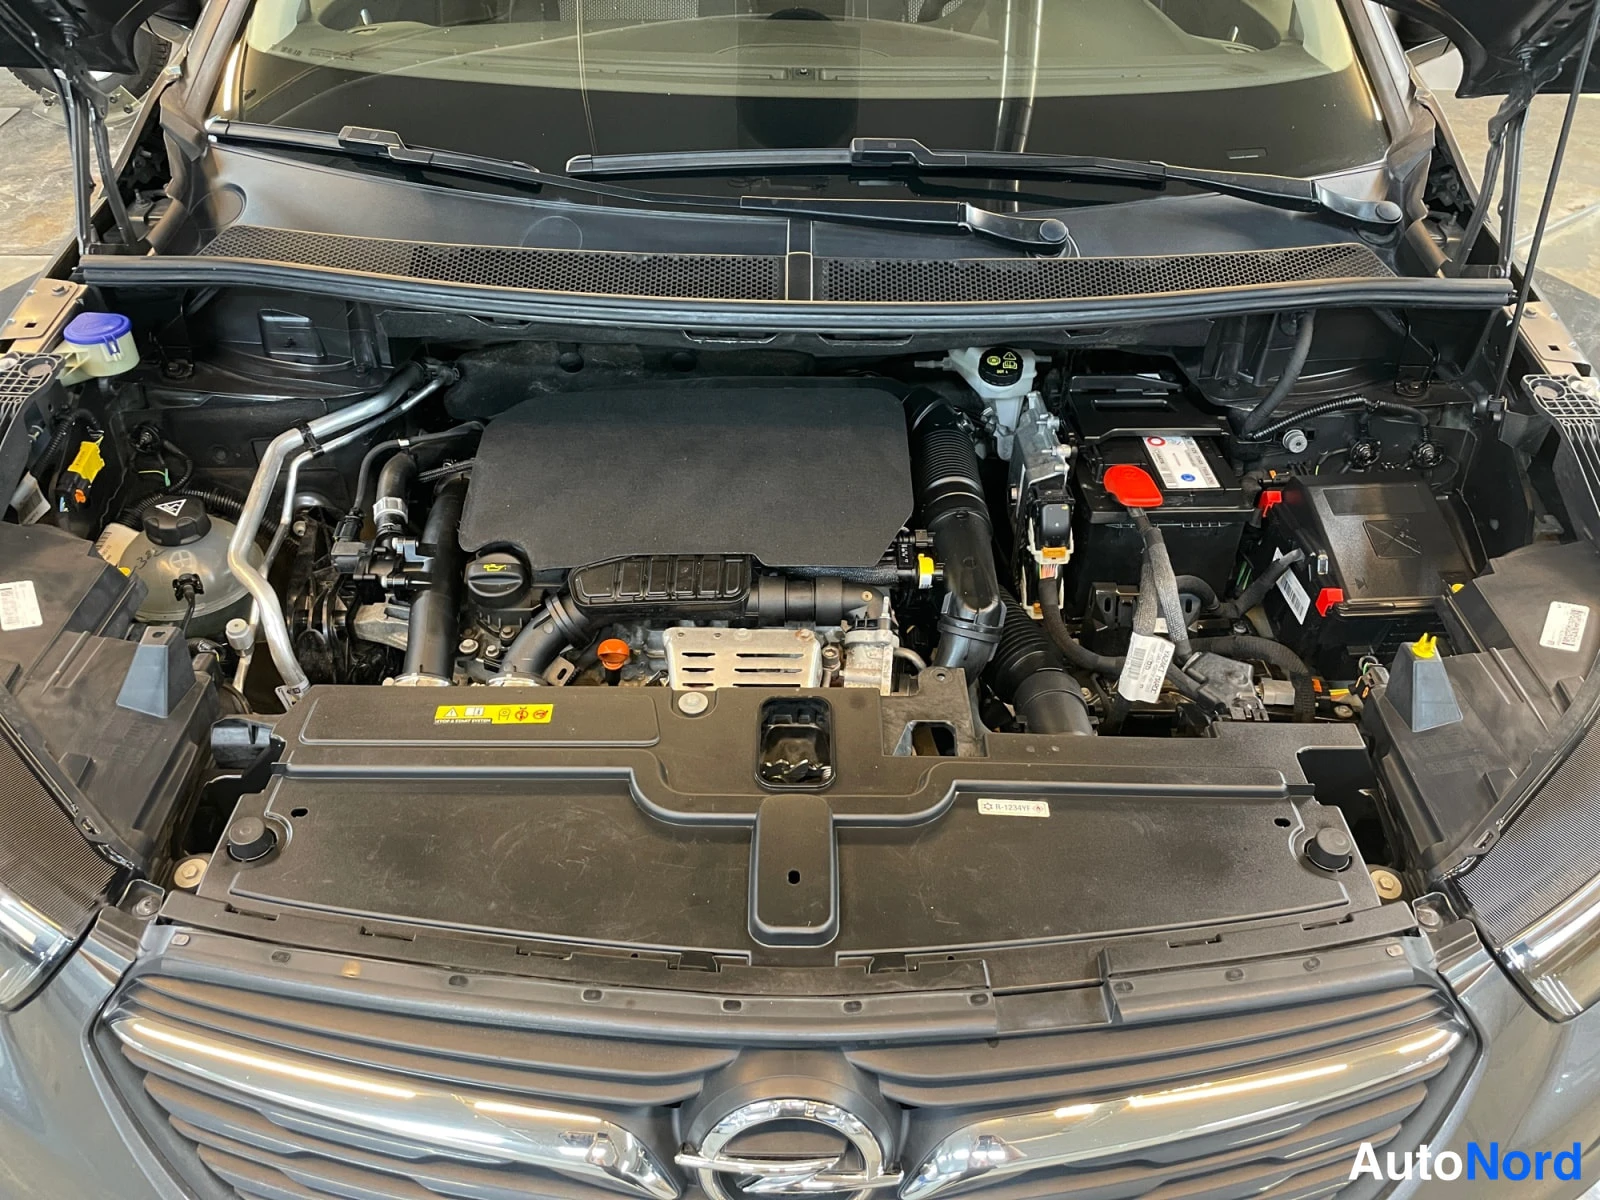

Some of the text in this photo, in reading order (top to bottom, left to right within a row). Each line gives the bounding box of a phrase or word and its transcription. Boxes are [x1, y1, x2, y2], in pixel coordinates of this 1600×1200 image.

[1158, 650, 1170, 673] YAZAKI
[1151, 675, 1162, 695] MAROC
[995, 803, 1030, 812] R-1234YF
